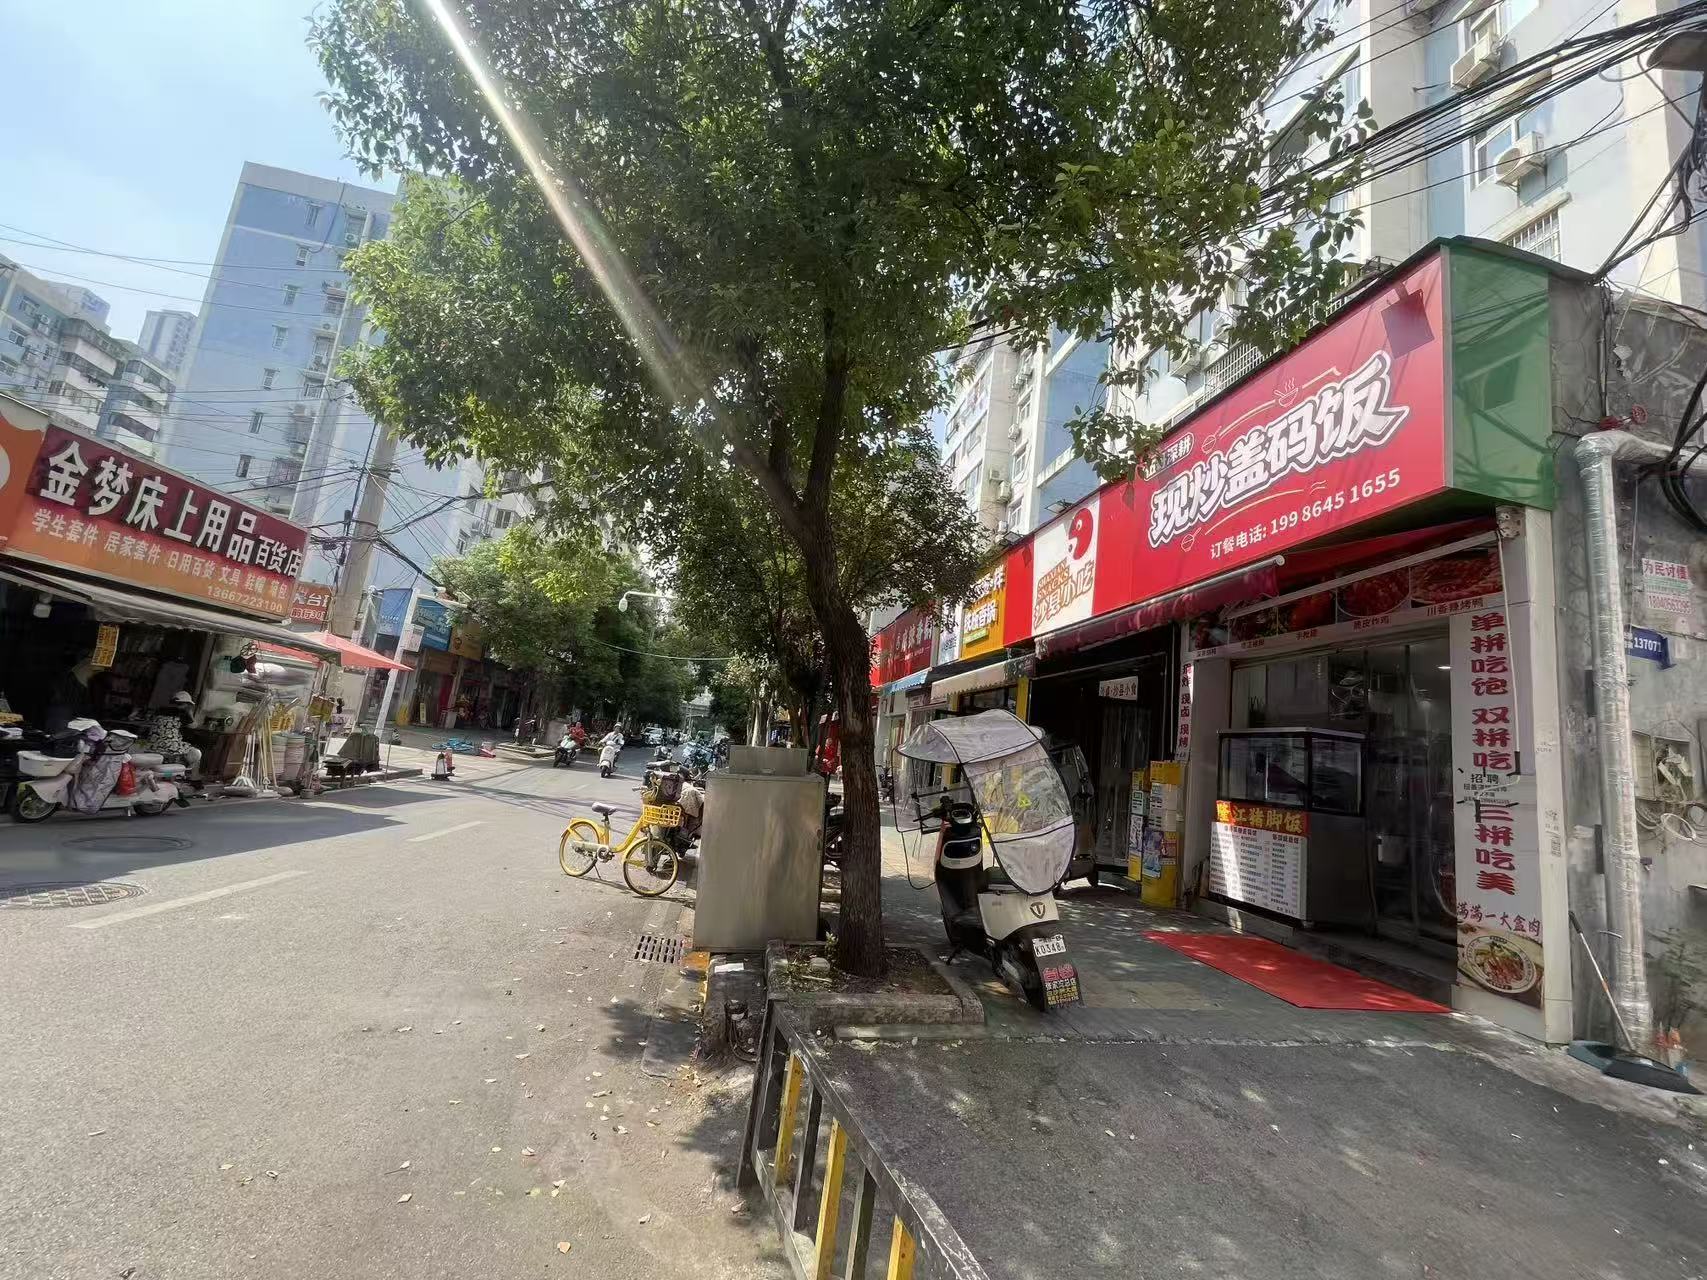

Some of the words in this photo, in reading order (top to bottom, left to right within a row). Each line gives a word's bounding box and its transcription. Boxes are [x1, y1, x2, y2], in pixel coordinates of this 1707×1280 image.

[1149, 351, 1409, 547] 现炒盖码饭
[32, 508, 99, 547] 学生套件
[104, 531, 162, 566] 居家套件
[167, 551, 216, 580] 日用百货
[220, 565, 242, 586] 文具
[1209, 523, 1268, 560] 订餐电话:
[1271, 511, 1307, 535] 199
[1302, 491, 1345, 523] 8645
[1349, 468, 1400, 504] 1655
[1034, 560, 1094, 630] 沙县小吃
[1470, 612, 1508, 696] 单拼吃饱
[1217, 802, 1303, 834] 隆江猪脚饭
[1470, 773, 1499, 785] 招聘
[1475, 803, 1516, 896] 三拼吃美
[1457, 902, 1541, 937] 满满一大盒肉
